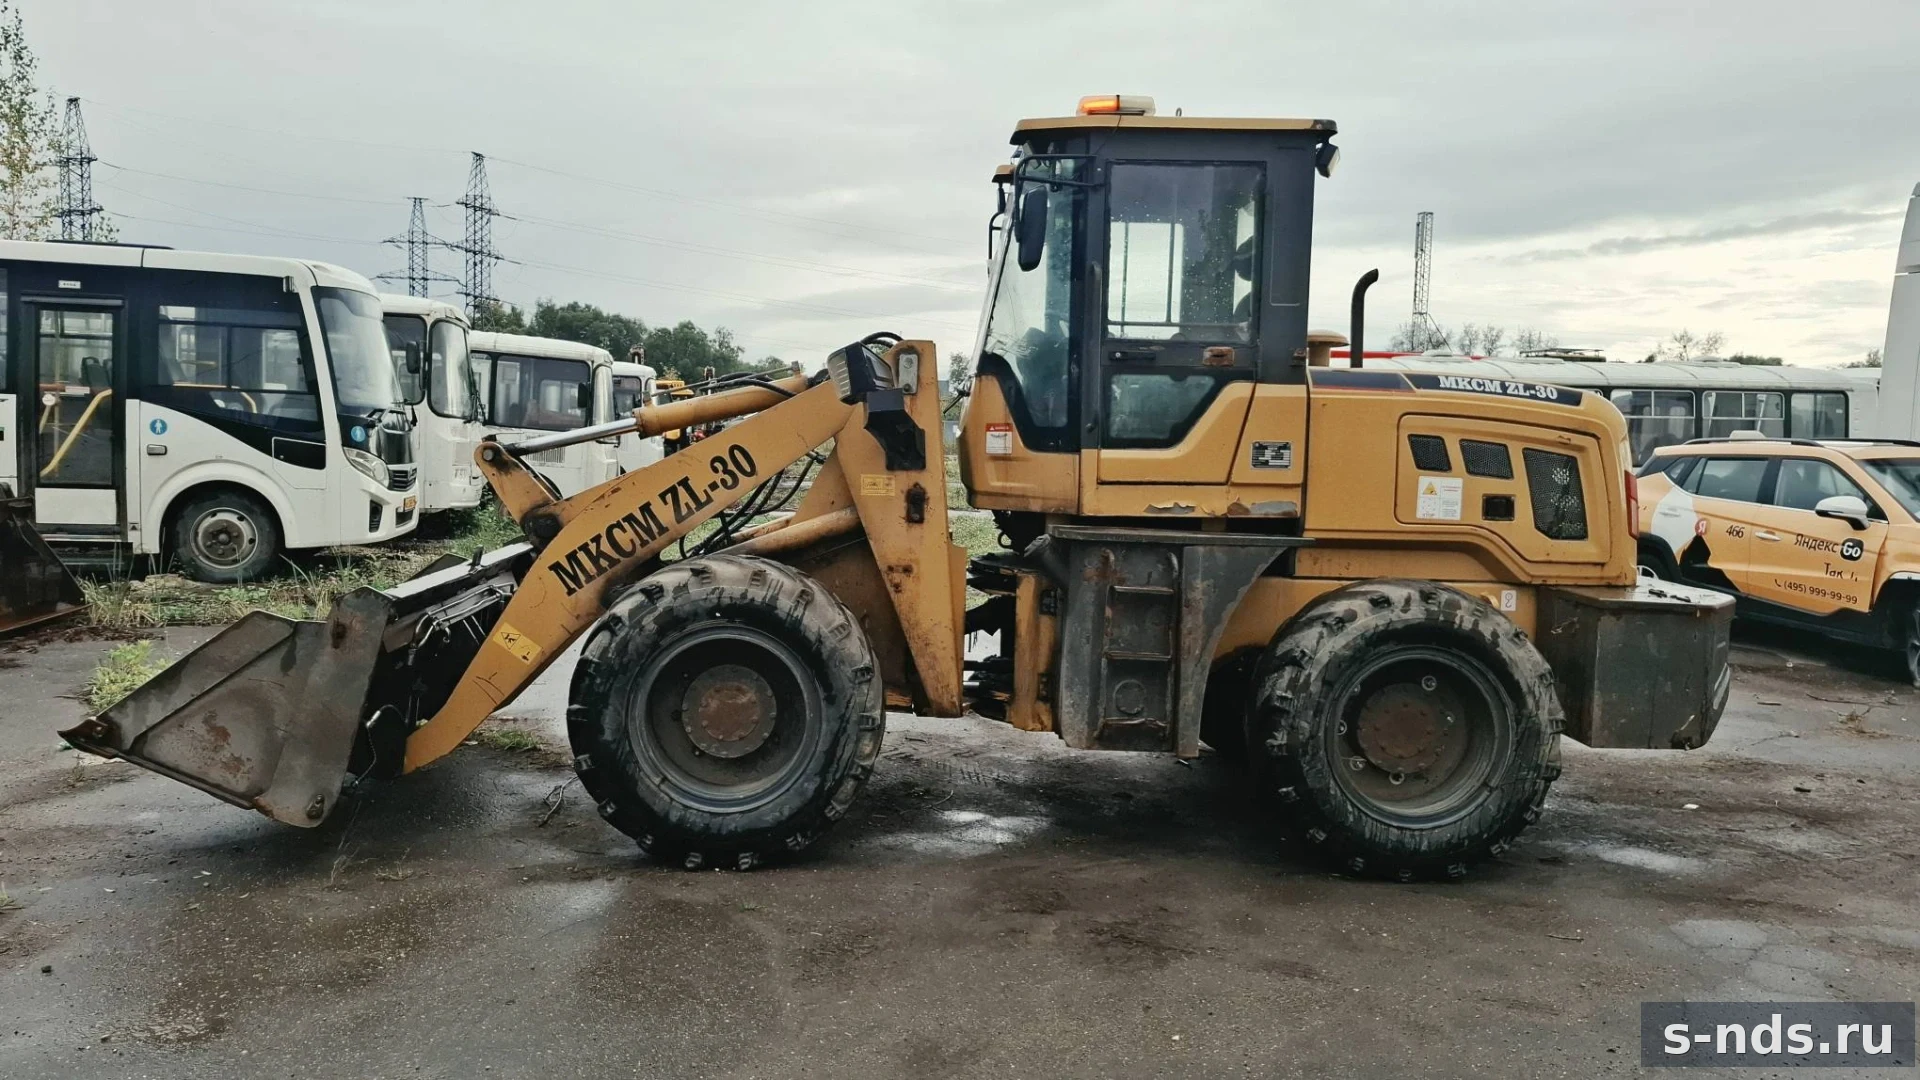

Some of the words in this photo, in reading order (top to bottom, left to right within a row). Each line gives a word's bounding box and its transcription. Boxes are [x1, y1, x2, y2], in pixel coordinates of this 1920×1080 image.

[1504, 381, 1558, 400] ZL-30
[658, 443, 757, 524] ZL-30
[1726, 524, 1745, 538] 466
[1794, 534, 1839, 553] Яндекс
[1842, 542, 1861, 558] Go
[1784, 580, 1807, 594] (495)
[1808, 586, 1858, 604] 999-99-99
